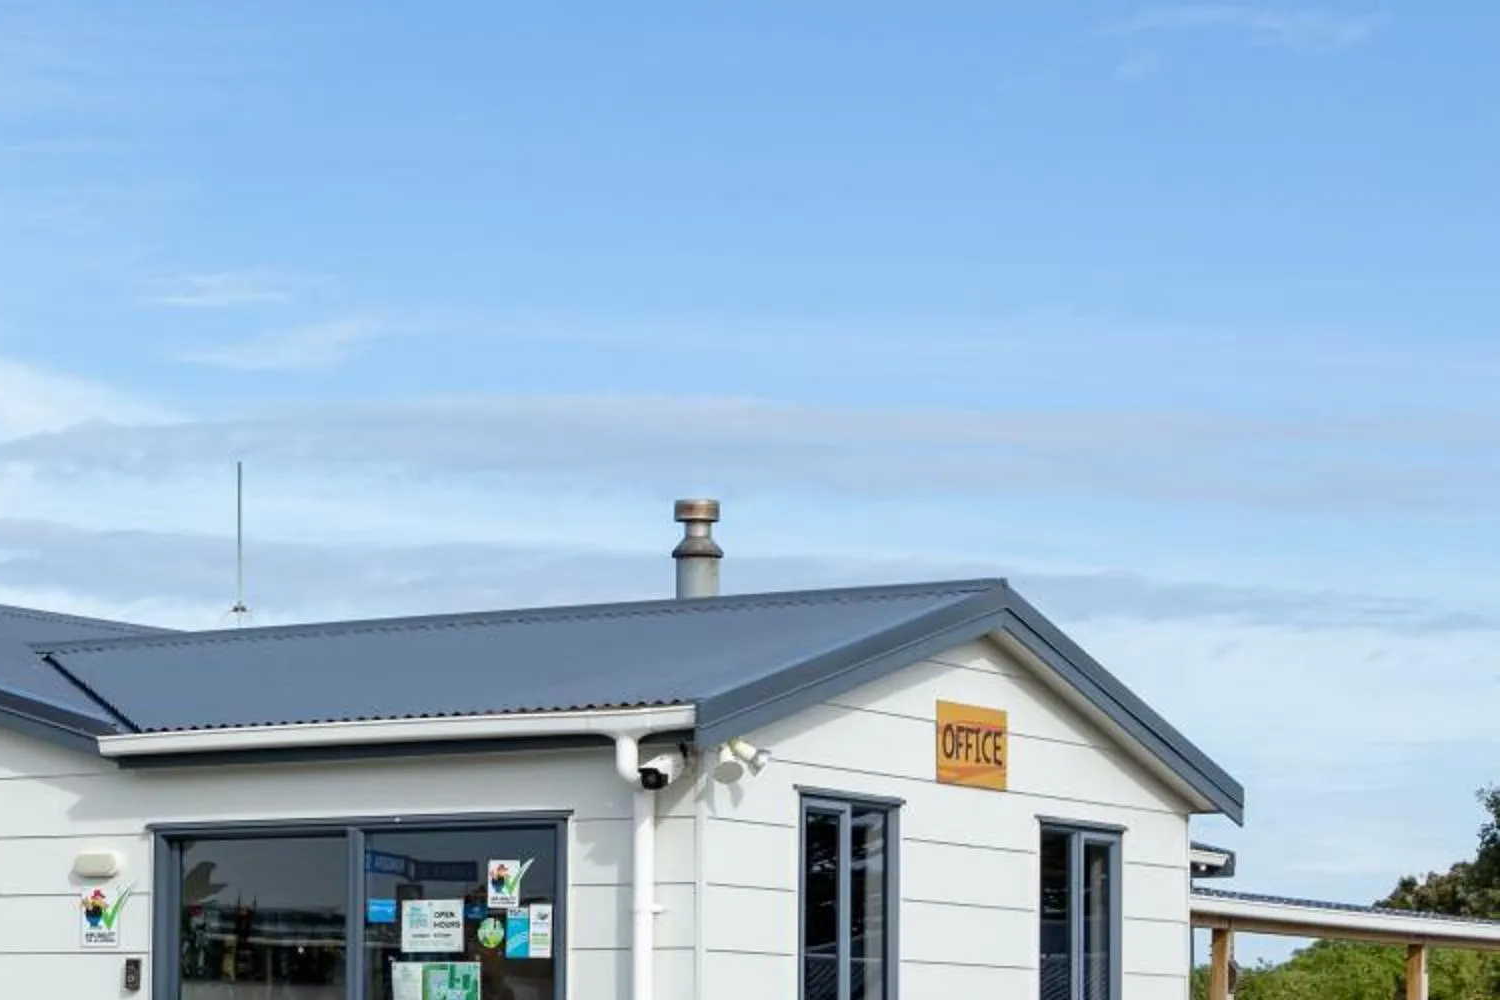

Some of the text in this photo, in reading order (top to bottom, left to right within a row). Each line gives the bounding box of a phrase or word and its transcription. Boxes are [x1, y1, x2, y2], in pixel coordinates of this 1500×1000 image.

[942, 723, 1003, 766] OFFICE
[433, 911, 455, 919] OPEN
[433, 921, 461, 929] HOURS
